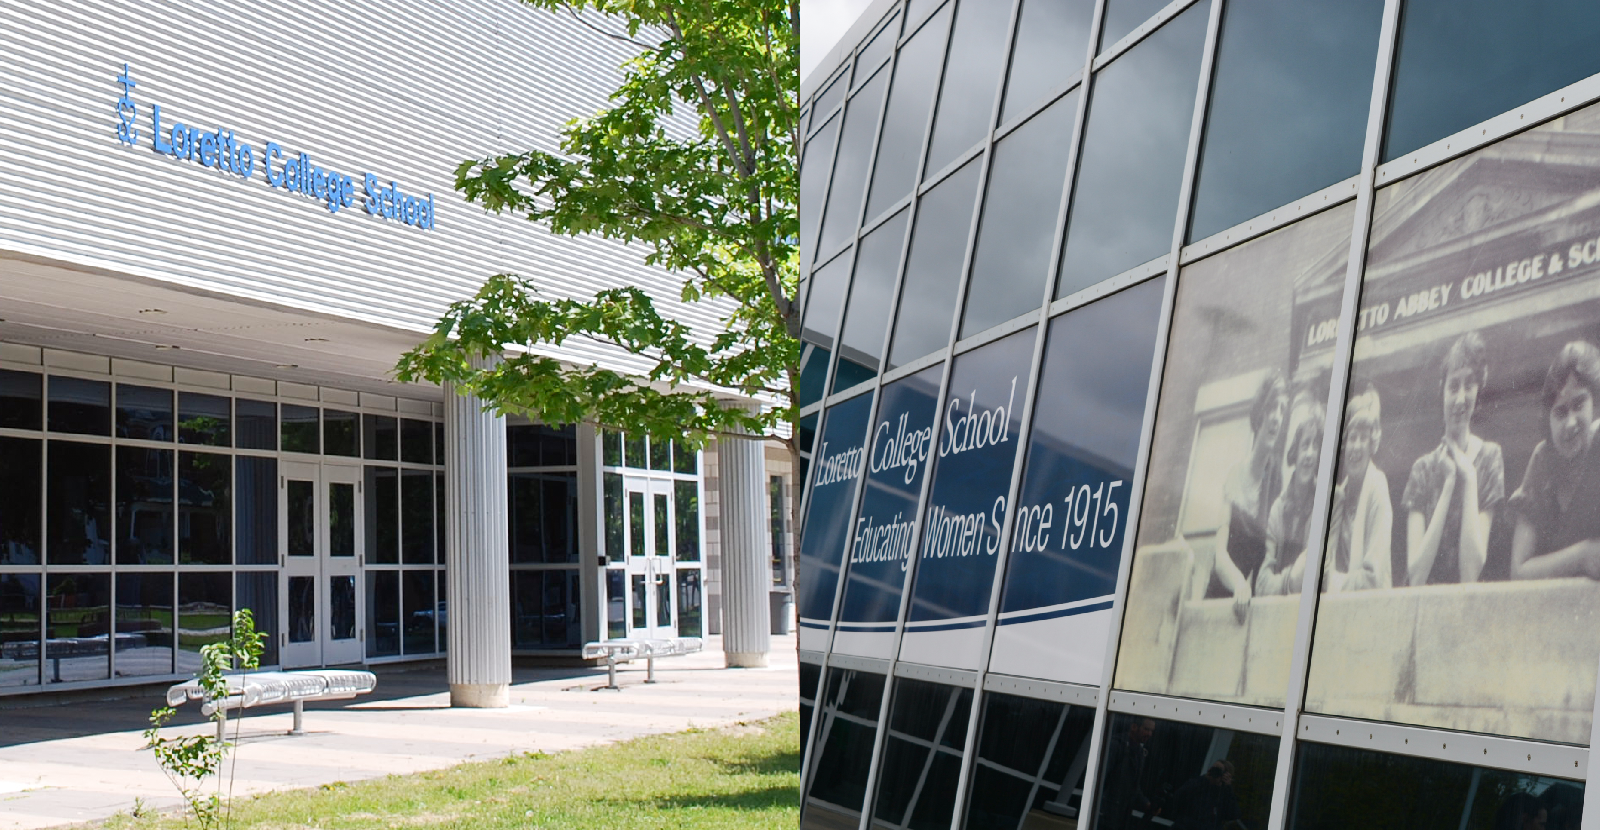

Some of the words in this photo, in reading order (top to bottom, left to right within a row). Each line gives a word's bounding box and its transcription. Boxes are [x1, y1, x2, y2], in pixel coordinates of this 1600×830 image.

[153, 104, 254, 177] Loretto
[265, 142, 354, 213] College
[365, 172, 434, 230] School
[1308, 303, 1390, 346] LORTTO
[1394, 283, 1453, 322] ABBEY
[1460, 255, 1545, 300] COLLEGE
[1548, 254, 1563, 275] &
[815, 442, 864, 487] Loretto
[870, 412, 932, 484] College
[939, 375, 1018, 458] School
[850, 512, 917, 572] Educating
[923, 505, 985, 559] Women
[986, 496, 1052, 555] Snce
[1061, 480, 1122, 550] 1915
